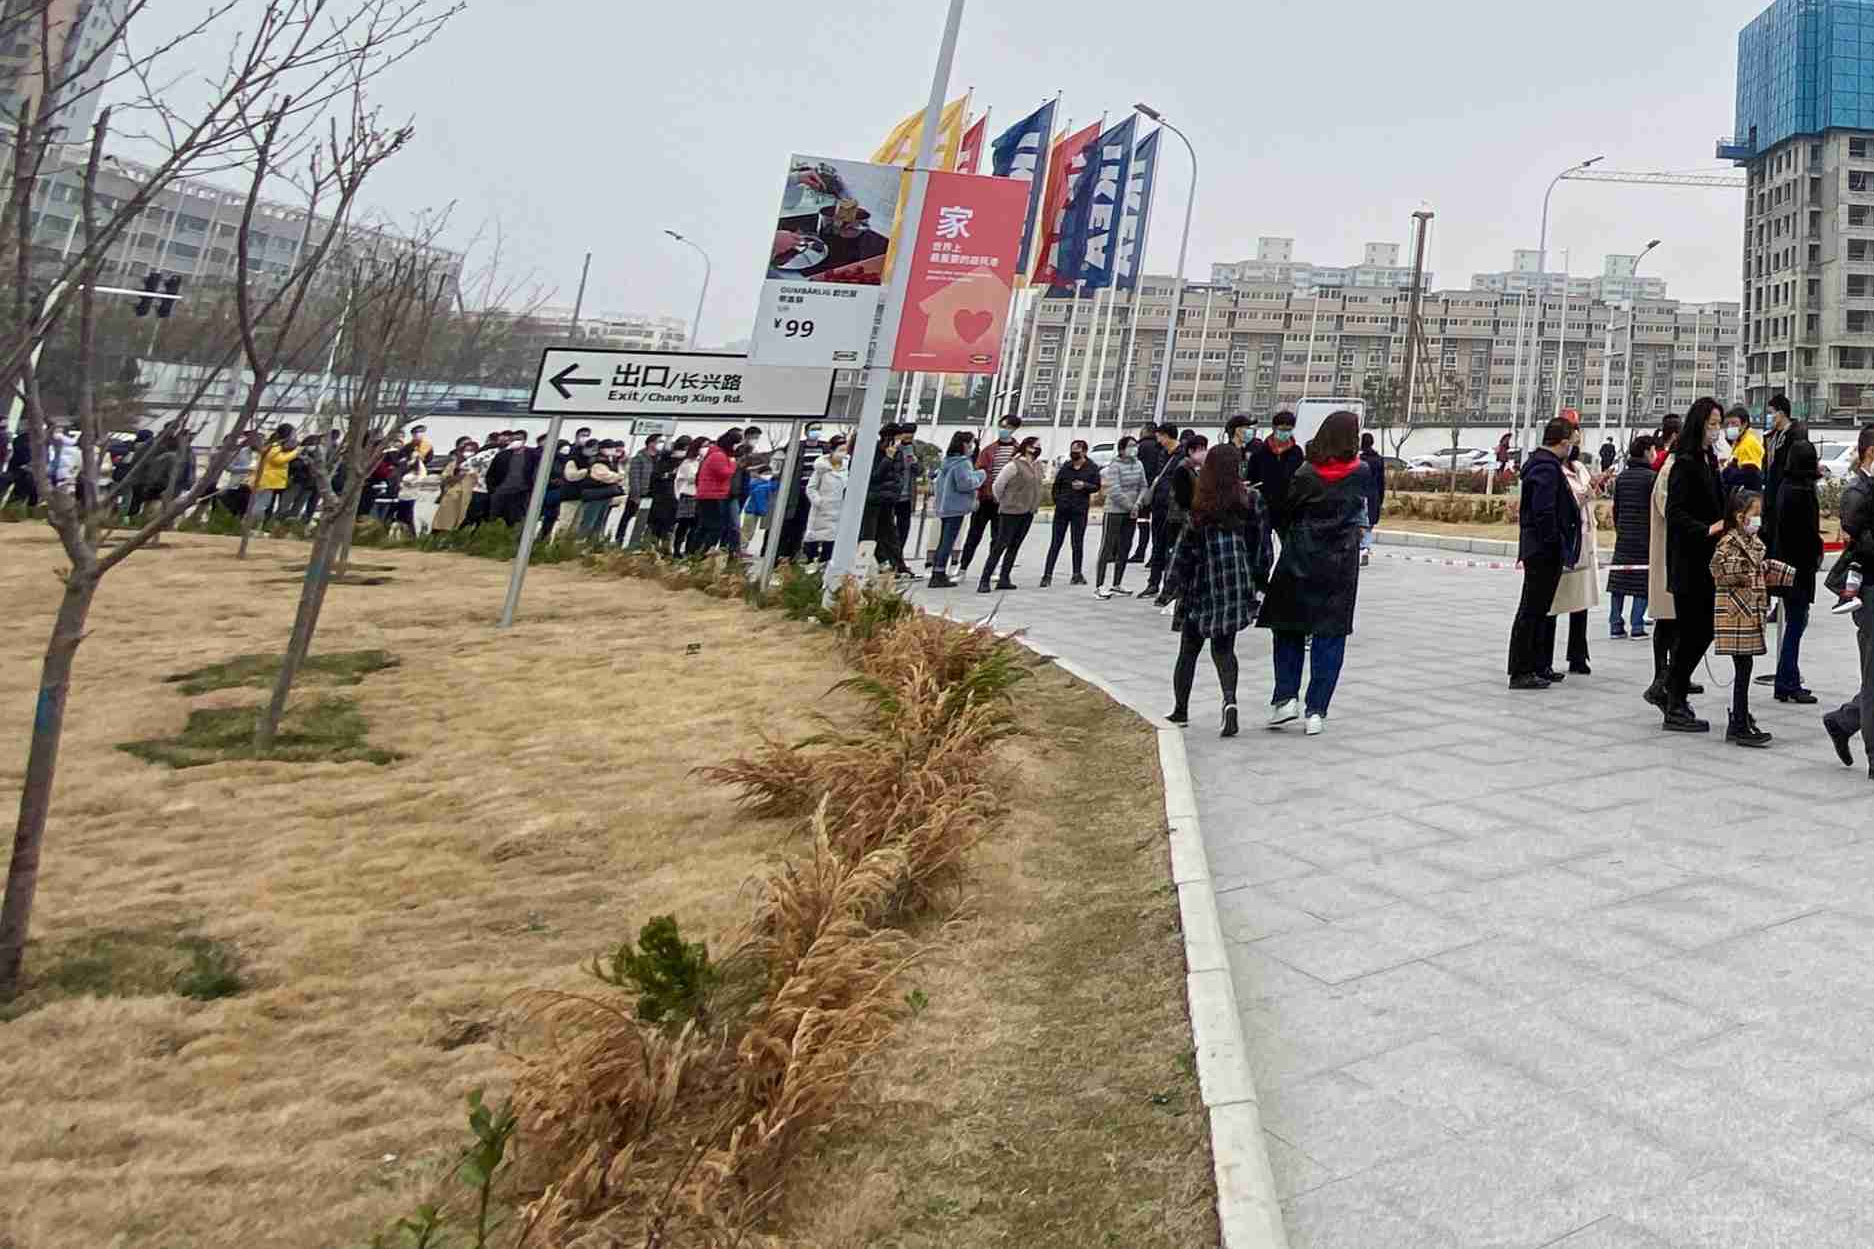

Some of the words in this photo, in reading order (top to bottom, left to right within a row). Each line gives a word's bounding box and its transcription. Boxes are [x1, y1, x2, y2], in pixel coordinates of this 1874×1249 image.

[936, 206, 974, 238] 家
[1084, 144, 1122, 270] IKEA
[691, 392, 720, 405] Xing
[723, 393, 744, 404] Rd.
